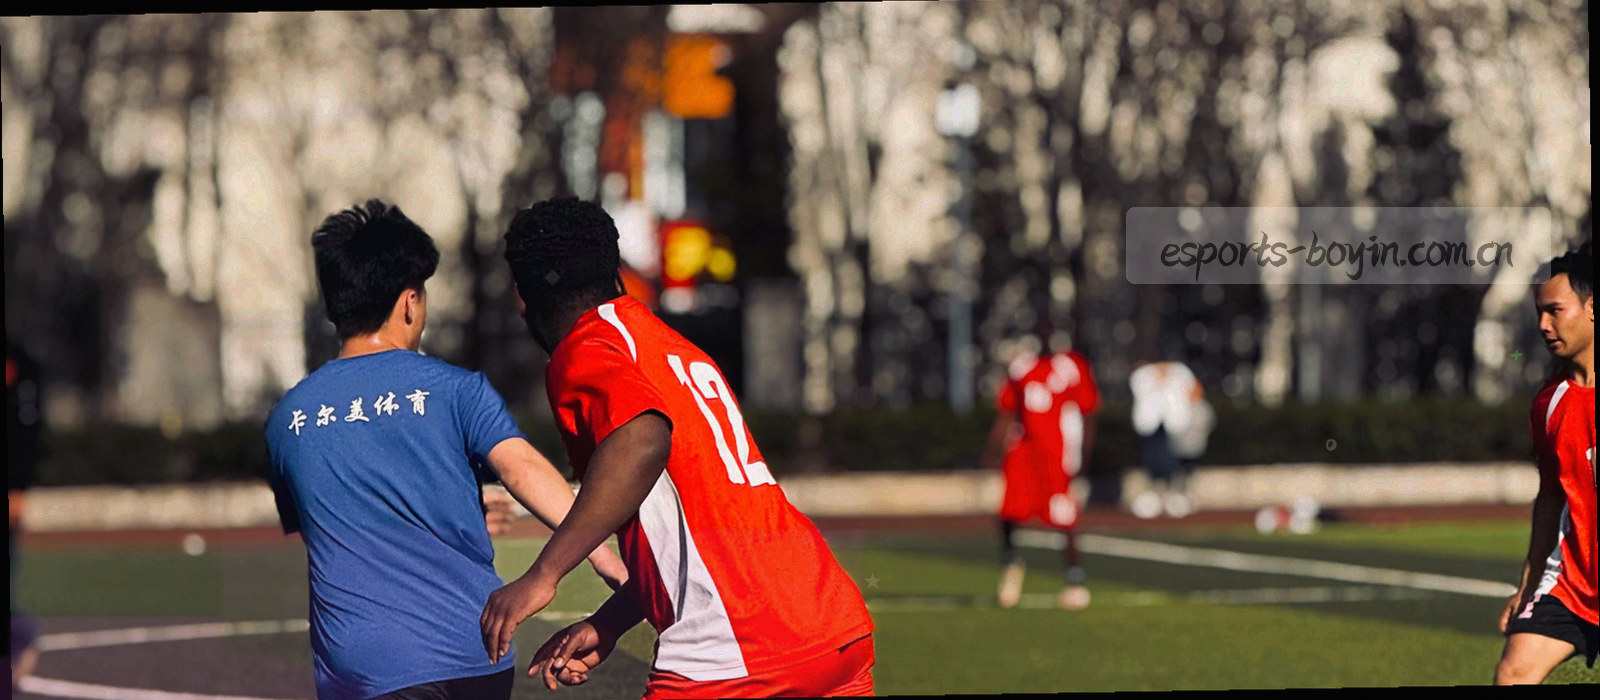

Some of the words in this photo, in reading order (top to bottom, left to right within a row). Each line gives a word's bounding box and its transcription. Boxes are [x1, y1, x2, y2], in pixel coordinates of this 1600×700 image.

[288, 389, 430, 436] 卡尔美体育
[667, 354, 777, 487] 12
